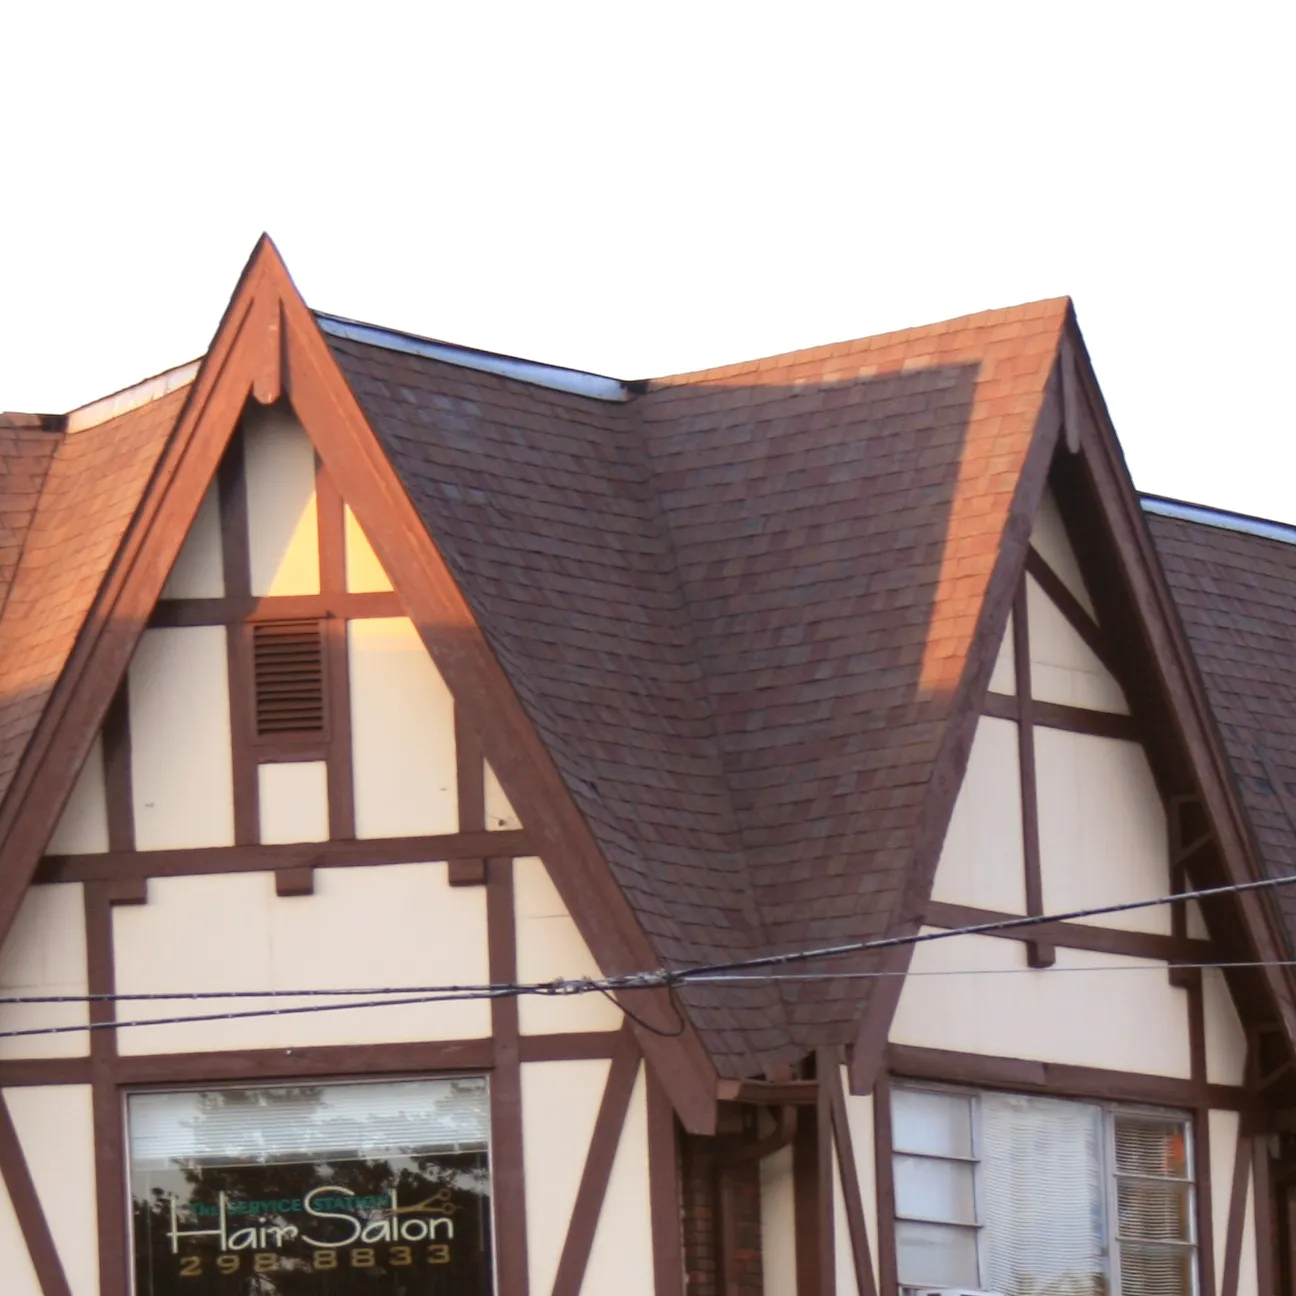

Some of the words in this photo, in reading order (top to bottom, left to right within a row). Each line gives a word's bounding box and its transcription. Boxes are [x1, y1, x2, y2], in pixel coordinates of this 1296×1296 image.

[166, 1190, 299, 1253] Hair
[301, 1185, 454, 1248] Salon
[227, 1199, 301, 1214] SERVICE
